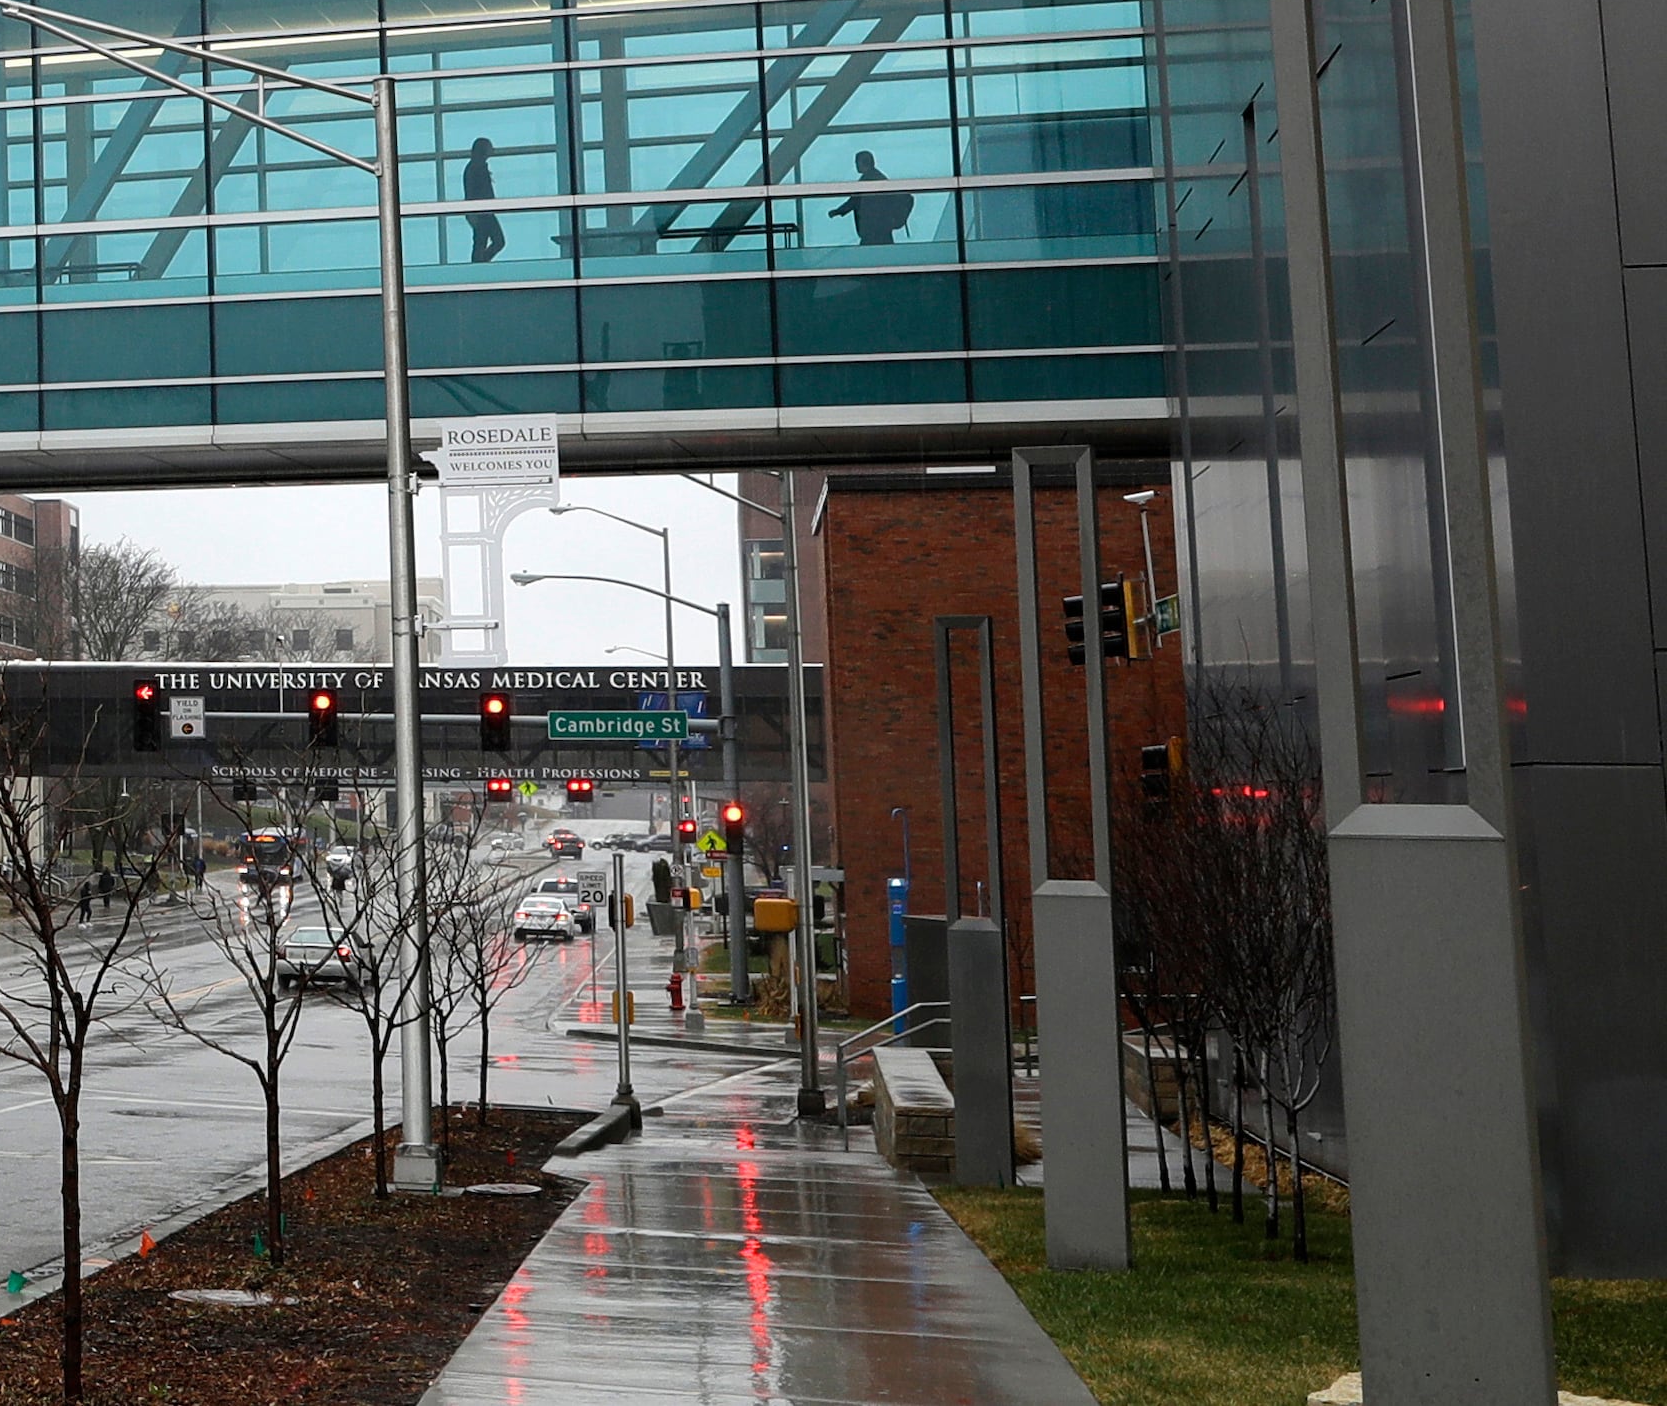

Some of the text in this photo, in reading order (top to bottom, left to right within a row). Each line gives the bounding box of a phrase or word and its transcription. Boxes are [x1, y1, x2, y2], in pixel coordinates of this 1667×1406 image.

[447, 427, 553, 445] ROSEDALE
[449, 459, 554, 472] WELCOMES YOU
[155, 672, 707, 690] THE UNIVERSITY OF NSAS MEDICAL CENTER
[555, 716, 681, 737] Cambridge St
[211, 765, 277, 777] SCHOOLS
[304, 766, 378, 778] MEDICNE
[477, 766, 536, 778] HEALTH
[542, 767, 641, 779] PROFESSIONS
[581, 890, 604, 903] 20
